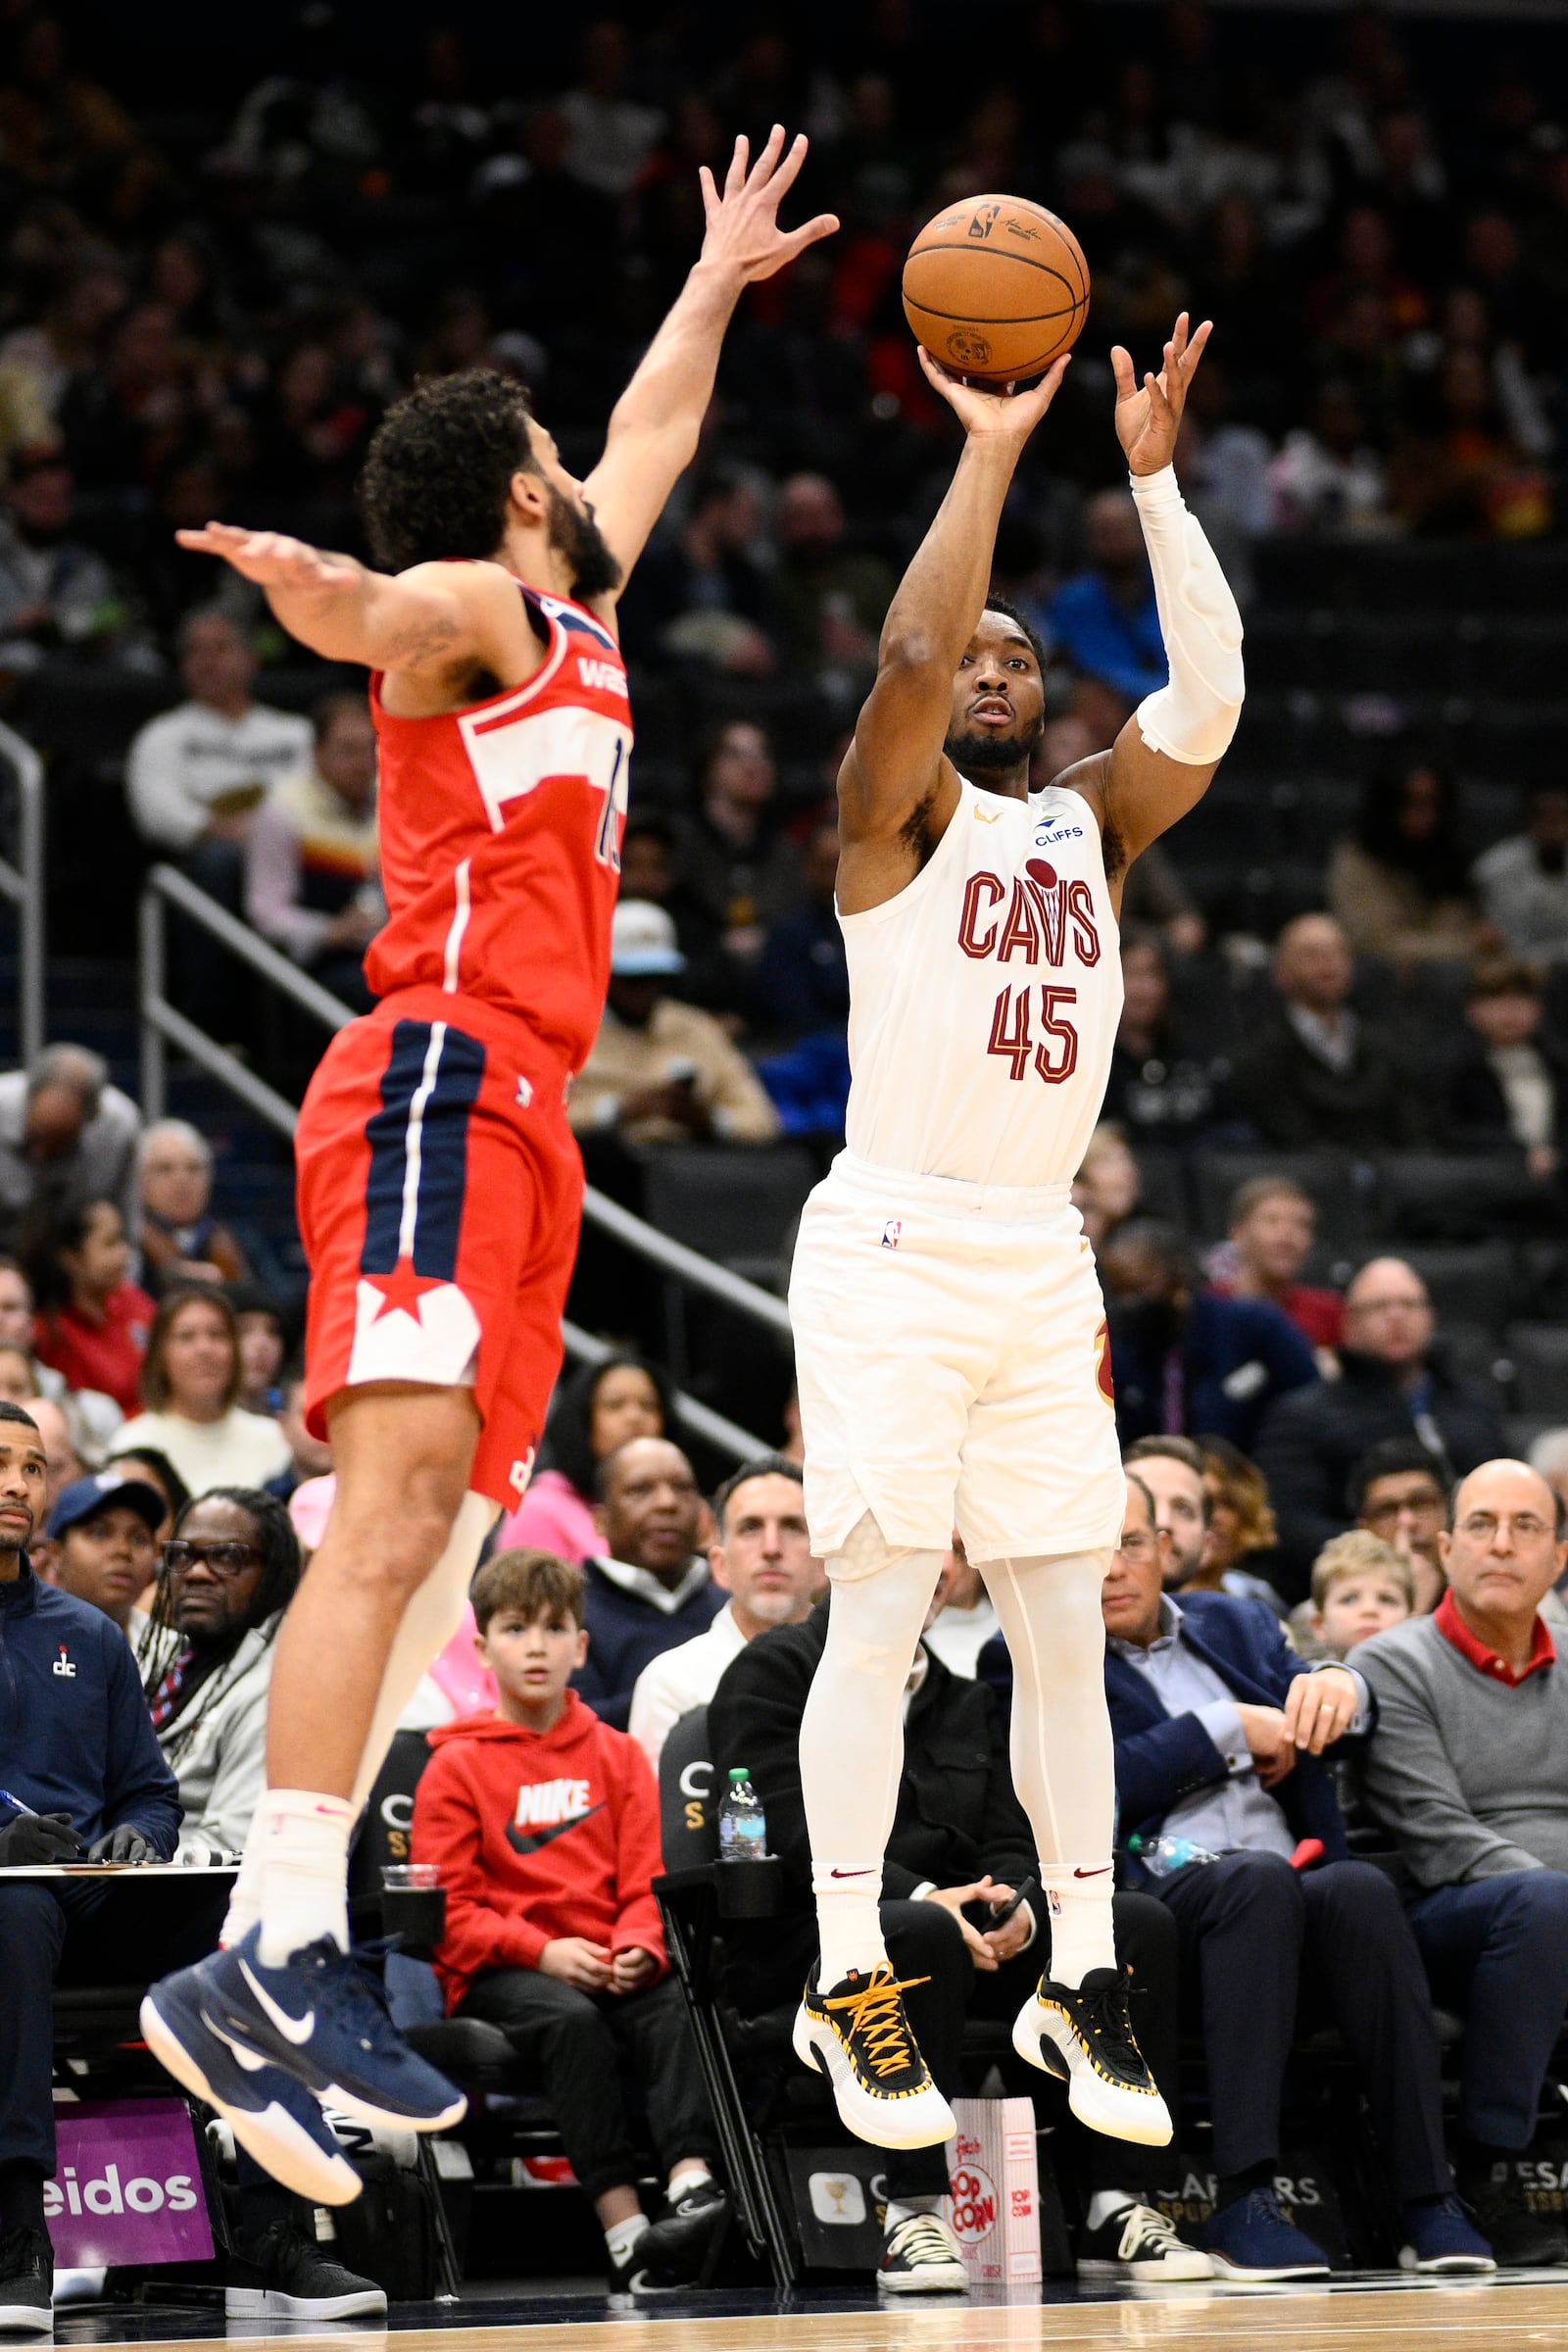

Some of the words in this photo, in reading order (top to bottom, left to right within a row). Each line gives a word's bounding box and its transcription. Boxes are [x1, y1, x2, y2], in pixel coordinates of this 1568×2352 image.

[1035, 826, 1084, 847] CLIFFS
[957, 869, 1101, 967] CAVS
[987, 983, 1078, 1084] 45
[514, 1779, 590, 1827] NIKE
